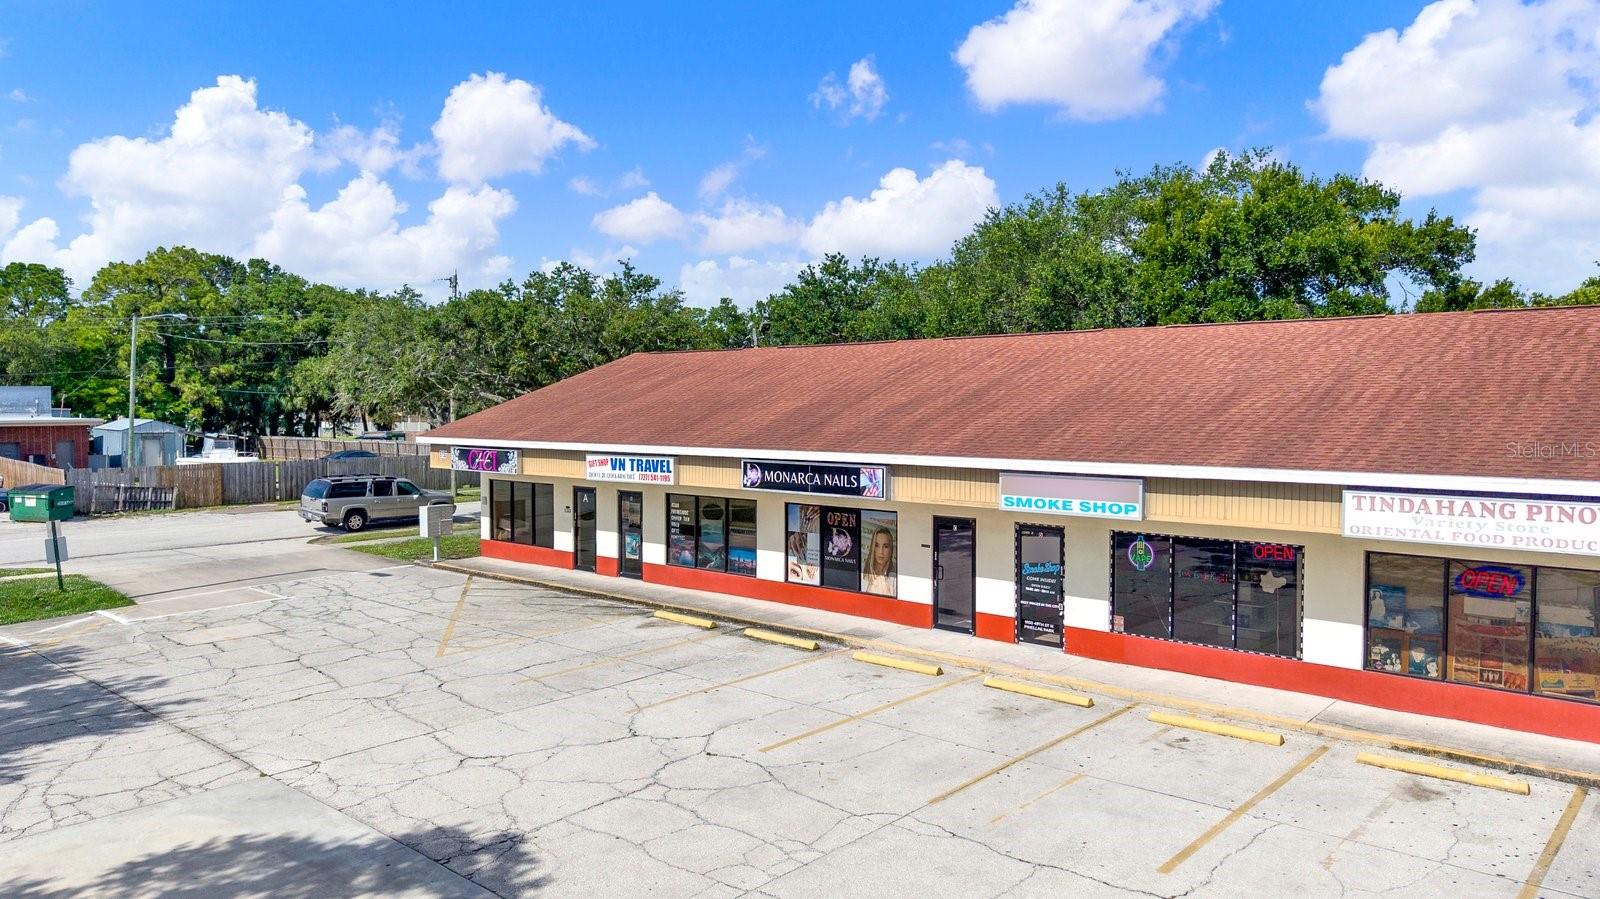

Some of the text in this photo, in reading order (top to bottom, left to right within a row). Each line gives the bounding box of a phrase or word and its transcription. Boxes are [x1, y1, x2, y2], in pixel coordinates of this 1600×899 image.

[610, 457, 672, 474] VN TRAVEL
[764, 470, 858, 488] MONARCA NAILS
[583, 493, 589, 502] A
[1003, 496, 1137, 515] SMOKE SHOP
[826, 511, 857, 527] OPEN
[1352, 495, 1600, 525] TINDAHANG PINO
[1350, 524, 1445, 541] ORIENTAL
[1452, 531, 1505, 545] FOOD
[1411, 516, 1551, 535] Variety Store
[1131, 553, 1151, 563] VAPE
[1253, 545, 1295, 561] OPEN
[1461, 570, 1518, 597] OPEN
